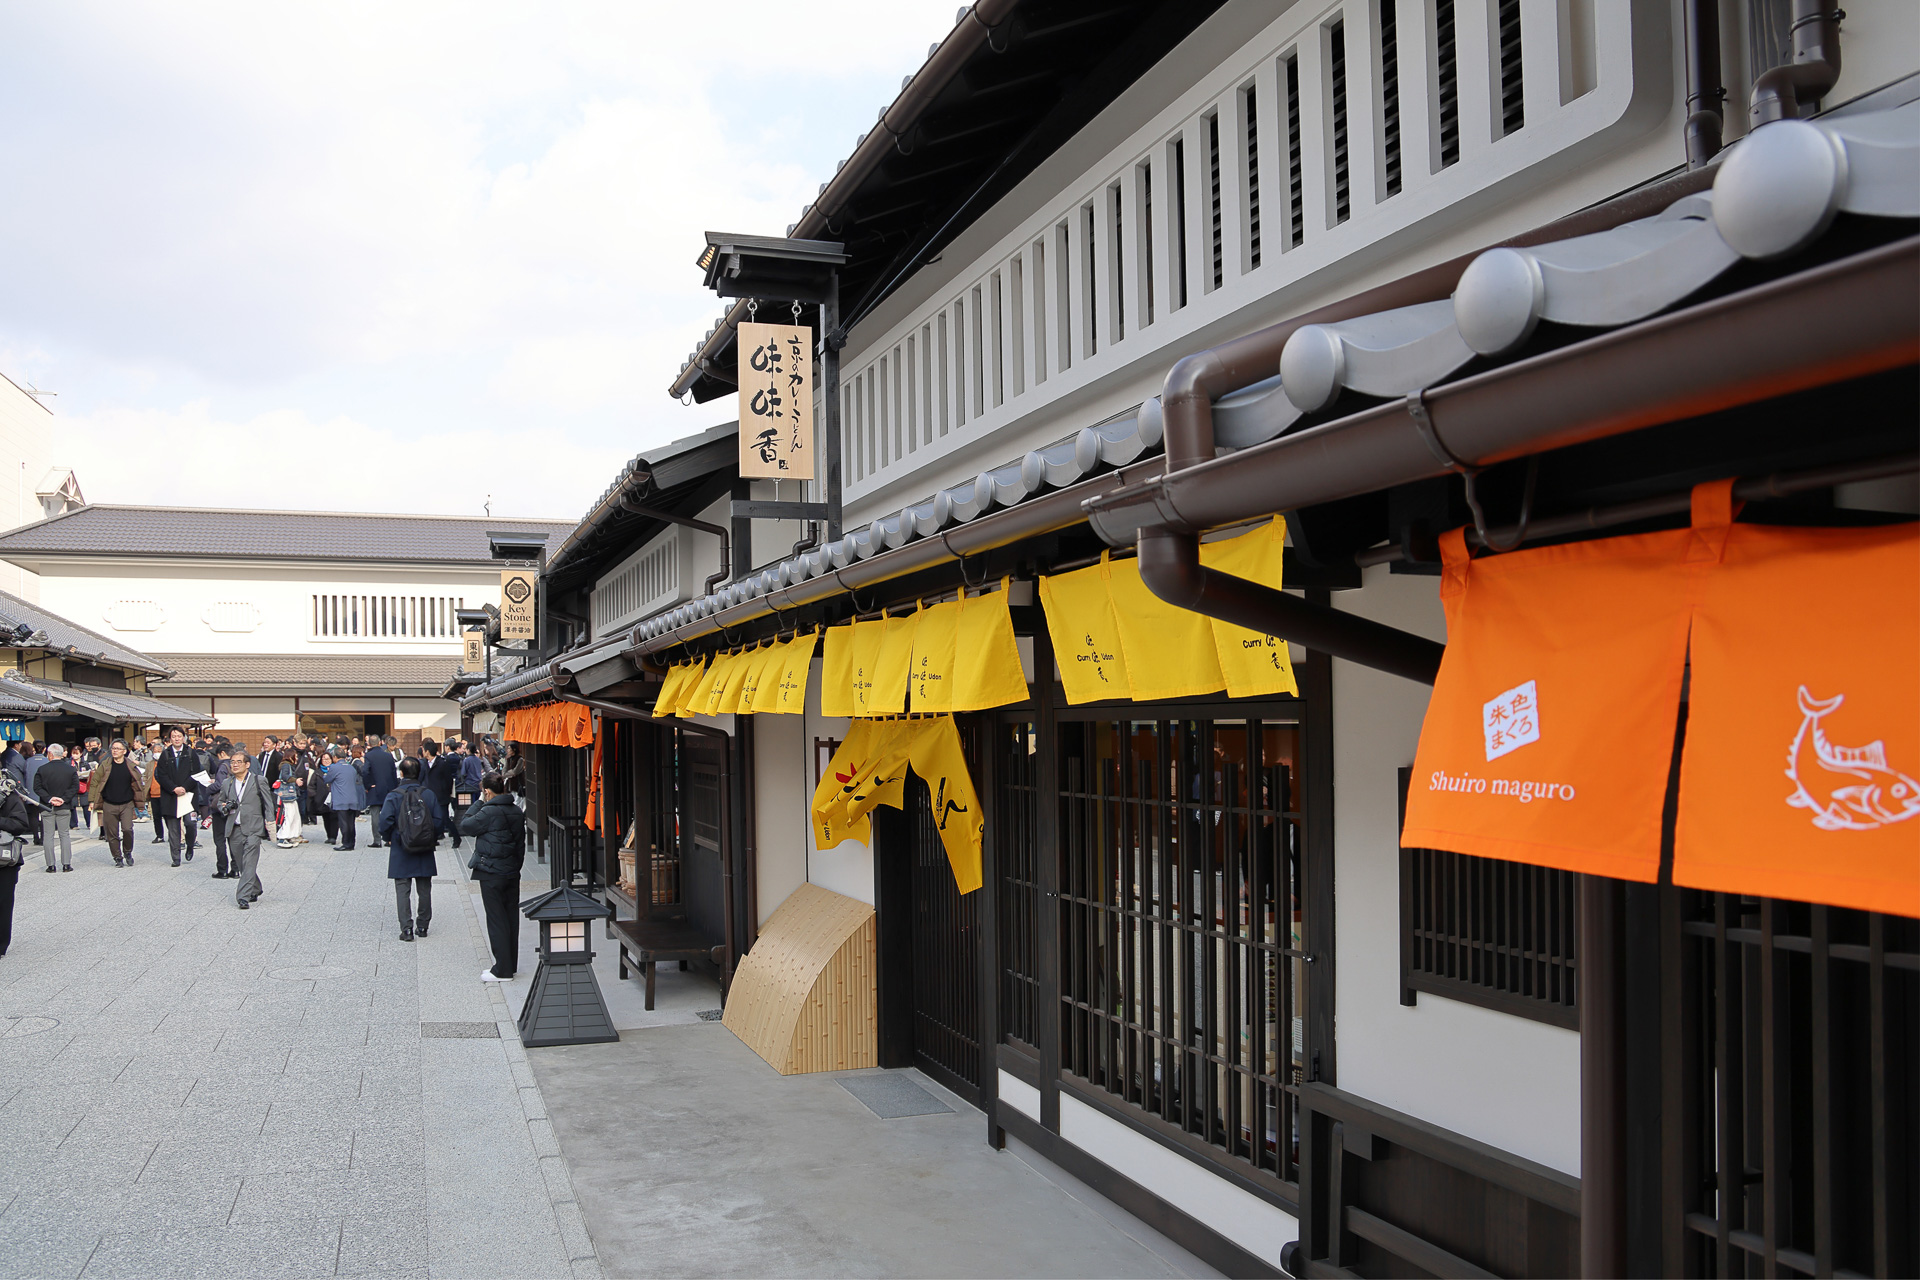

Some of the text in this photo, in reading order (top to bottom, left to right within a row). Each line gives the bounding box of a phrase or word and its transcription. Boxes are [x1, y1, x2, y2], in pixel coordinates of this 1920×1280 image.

[750, 336, 784, 464] 味味香
[787, 335, 804, 453] 京のカレーうどん
[504, 612, 531, 621] Stone
[509, 604, 527, 615] Key
[1242, 639, 1262, 649] Curry
[1488, 693, 1533, 727] 朱色
[1429, 770, 1576, 804] Shuiro maguro
